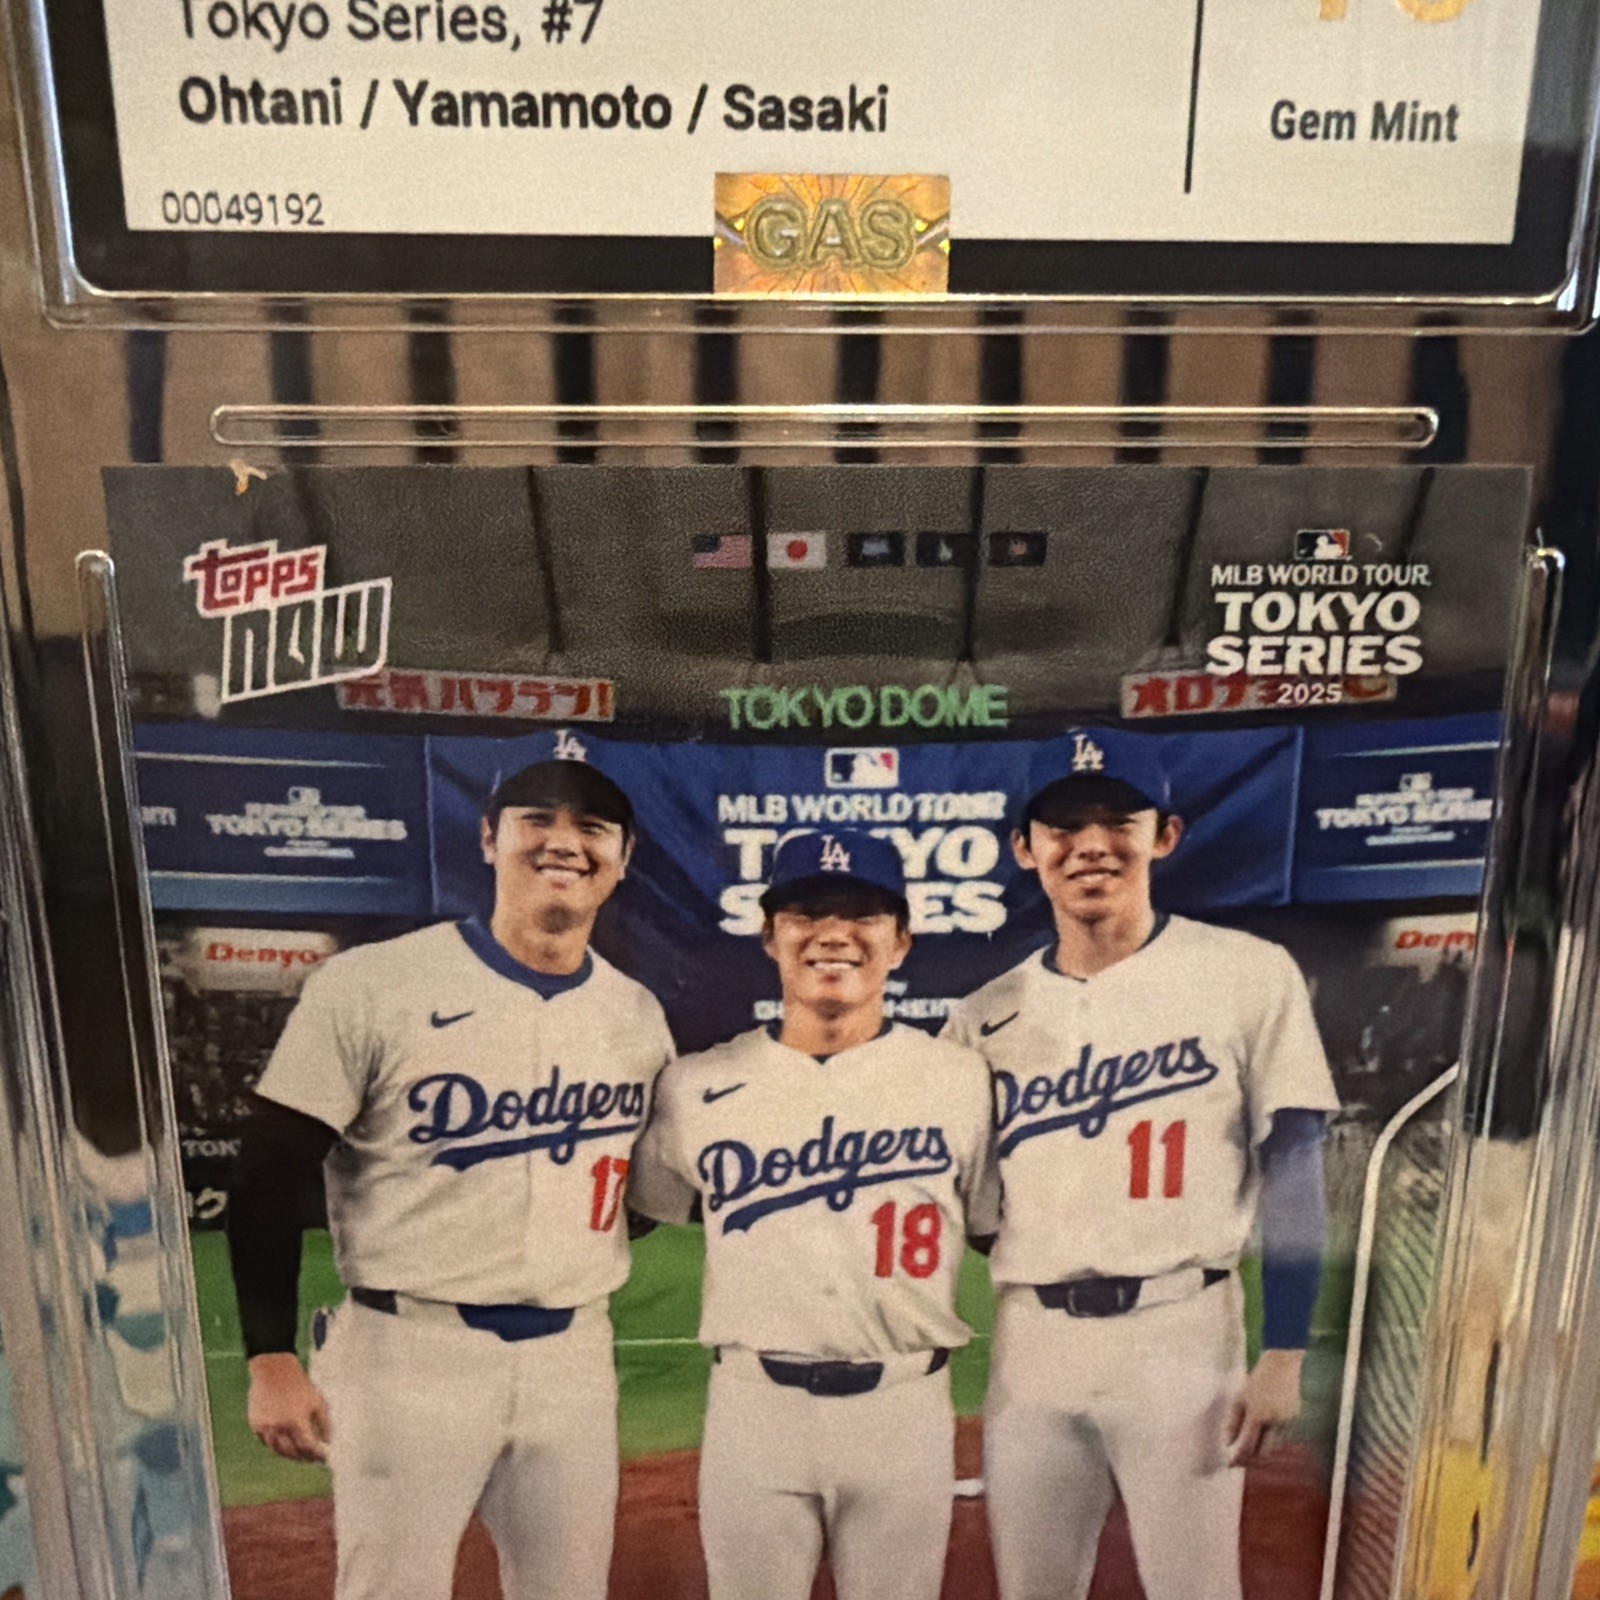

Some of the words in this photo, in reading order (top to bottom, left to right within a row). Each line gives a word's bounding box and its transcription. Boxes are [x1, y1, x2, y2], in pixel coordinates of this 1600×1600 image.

[180, 0, 330, 52] Tokyo
[347, 0, 521, 50] Series,
[541, 0, 604, 44] #7
[178, 76, 342, 127] Ohtani
[359, 79, 379, 130] /
[392, 80, 673, 132] Yamamoto
[687, 83, 708, 134] /
[723, 84, 888, 132] Sasaki
[1270, 100, 1356, 141] Gem
[1370, 101, 1459, 142] Mint
[161, 190, 324, 226] 00049192
[745, 196, 916, 270] GAS
[1210, 563, 1263, 587] MLB
[1267, 563, 1359, 586] WORLD
[1363, 563, 1430, 587] TOUR
[1214, 591, 1421, 633] TOKYO
[1206, 635, 1423, 676] SERIES
[719, 683, 873, 730] TOKYO
[879, 683, 1009, 728] DOME
[1276, 682, 1344, 705] 2025
[552, 728, 588, 763] LA
[1071, 734, 1105, 771] LA
[717, 794, 788, 824] MLB
[791, 793, 913, 822] WORLD
[723, 825, 1000, 881] TYO
[820, 834, 851, 872] LA
[718, 880, 1009, 936] SES
[205, 942, 321, 968] Denyo
[408, 1065, 645, 1164] Dodgers
[699, 1117, 953, 1212] Dodgers
[1126, 1119, 1187, 1200] 11
[870, 1200, 942, 1279] 18
